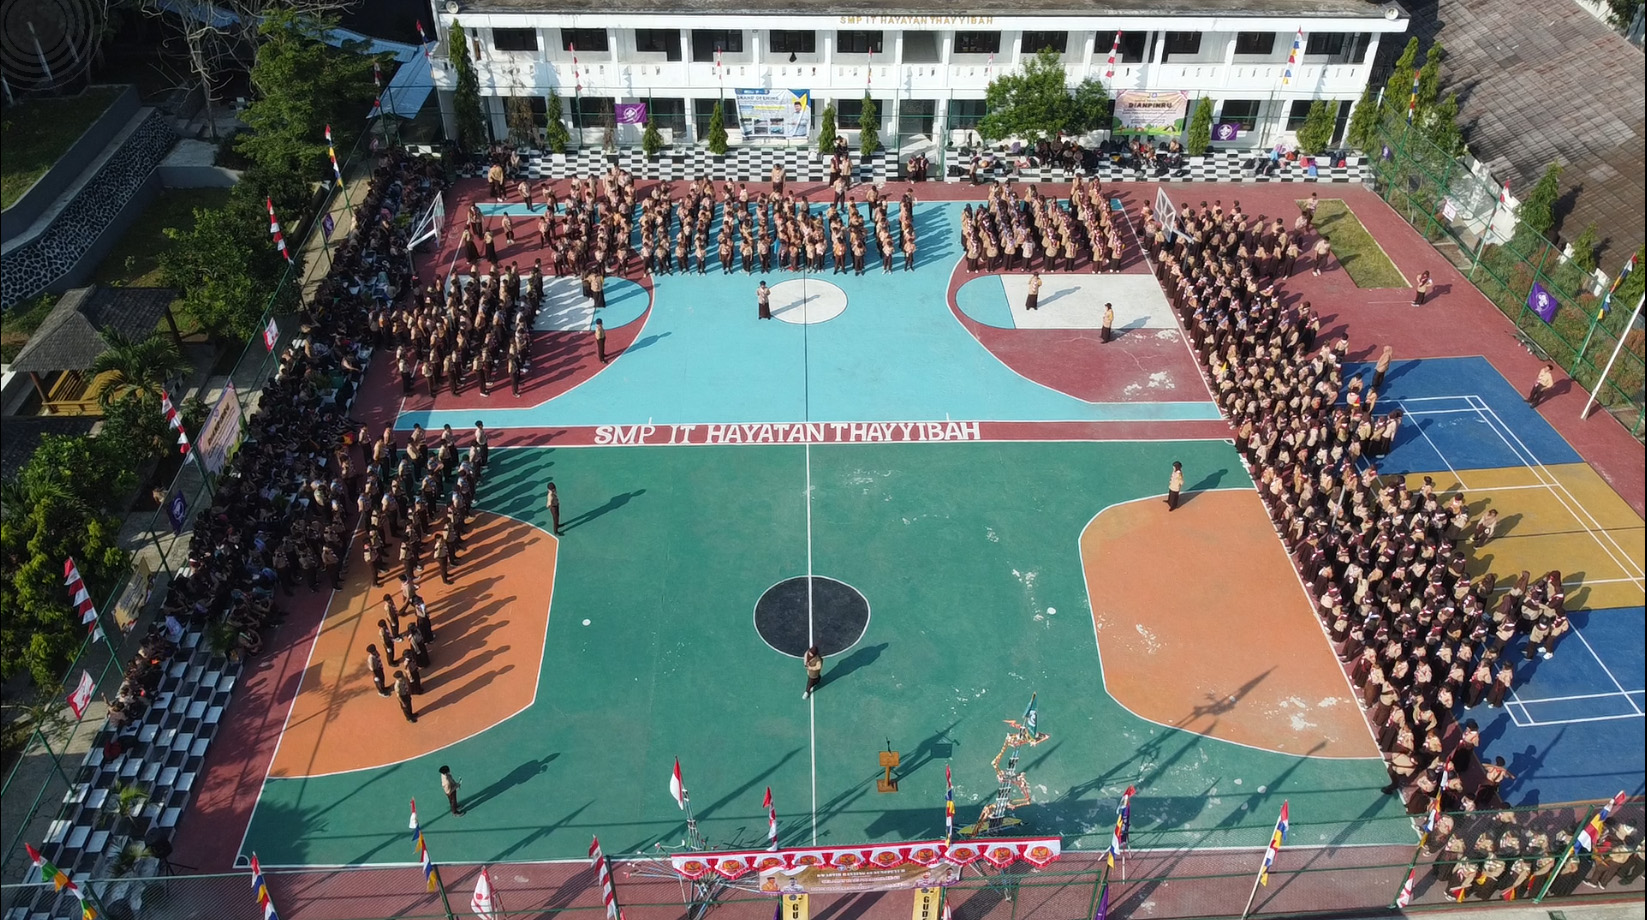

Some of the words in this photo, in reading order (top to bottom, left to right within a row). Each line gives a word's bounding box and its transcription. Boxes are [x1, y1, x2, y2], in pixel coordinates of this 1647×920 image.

[840, 16, 862, 24] SMP
[866, 16, 876, 24] IT
[880, 16, 927, 24] HAYATAN
[594, 425, 656, 445] SMP
[668, 425, 696, 444] IT
[706, 422, 825, 444] HAYATAN
